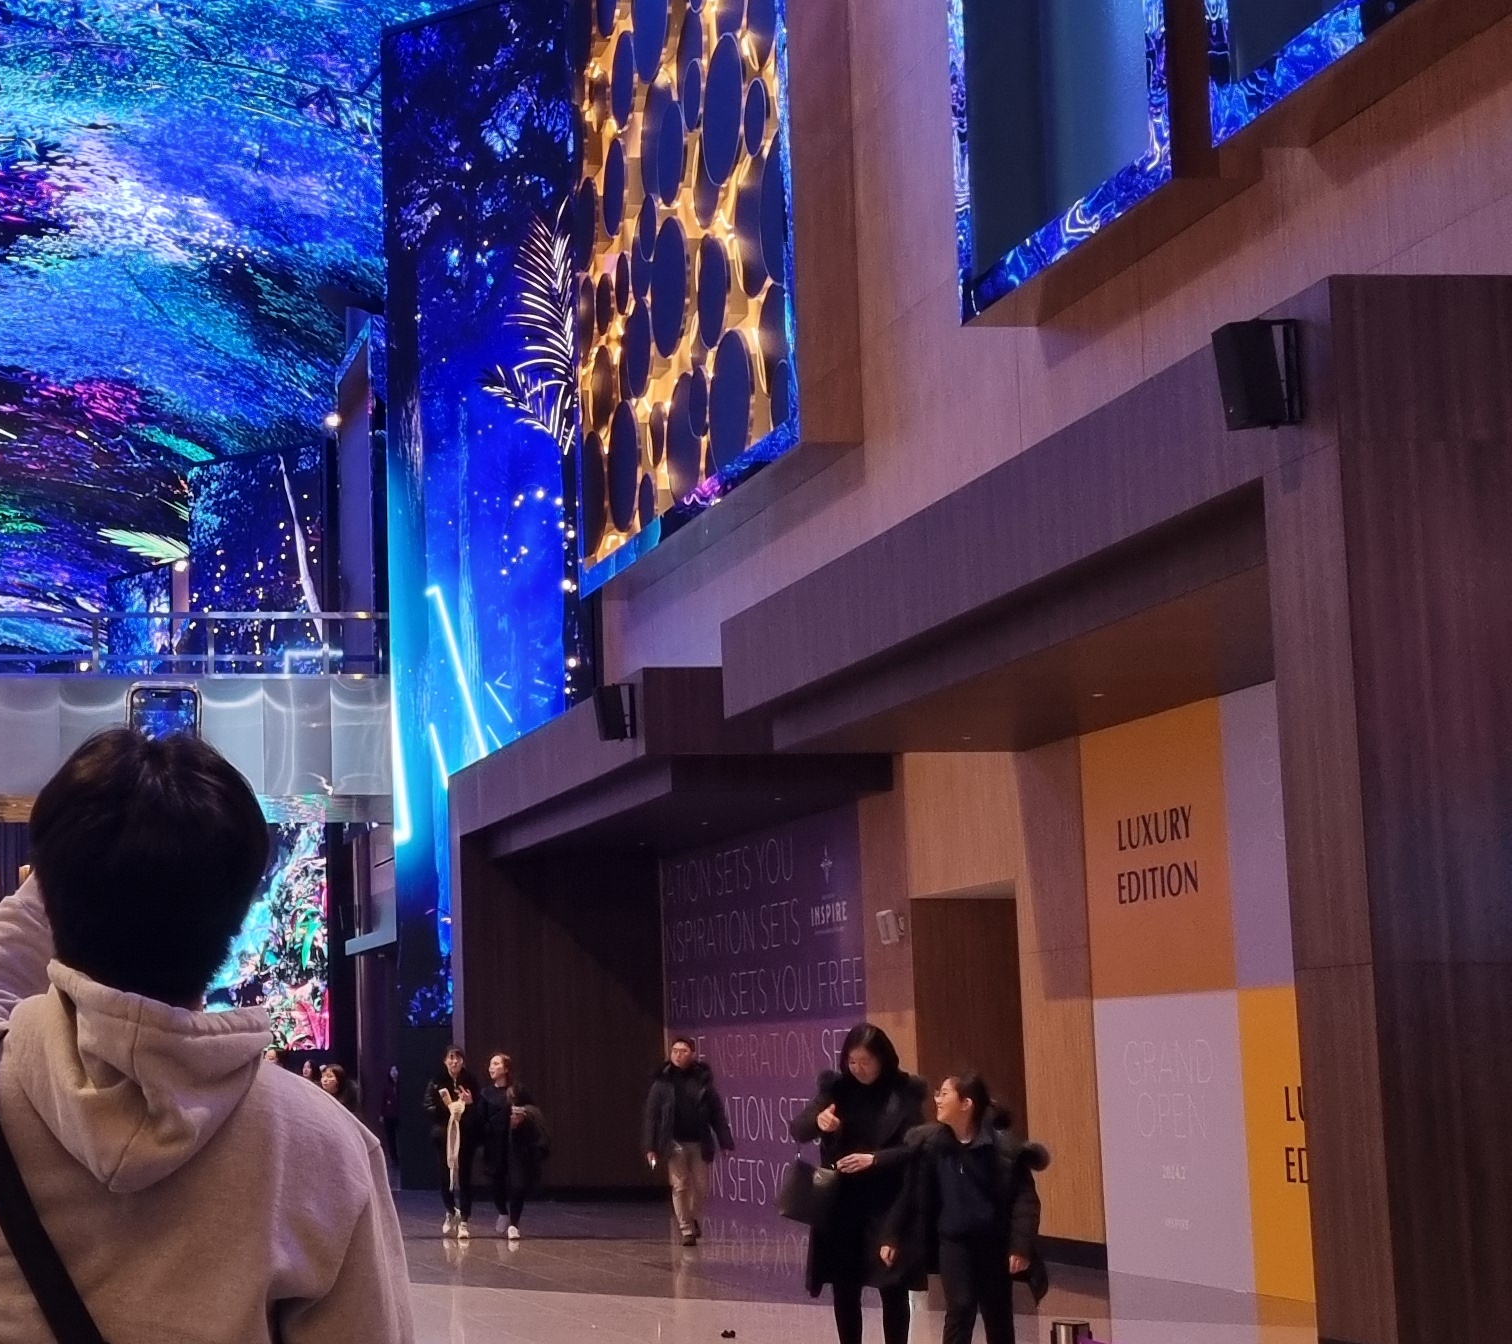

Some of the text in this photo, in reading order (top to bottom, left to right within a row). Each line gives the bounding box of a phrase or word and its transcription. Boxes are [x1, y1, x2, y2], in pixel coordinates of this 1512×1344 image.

[1117, 805, 1192, 852] LUXURY
[715, 844, 752, 896] SETS
[755, 836, 794, 885] YOU
[1117, 859, 1199, 905] EDITION
[759, 897, 801, 951] SETS
[810, 900, 848, 928] INSPIRE
[729, 967, 768, 1017] SETS
[771, 964, 811, 1013] YOU
[817, 956, 865, 1009] FREE
[1123, 1037, 1214, 1086] GRAND
[1136, 1091, 1207, 1140] OPEN
[727, 1156, 768, 1207] SETS
